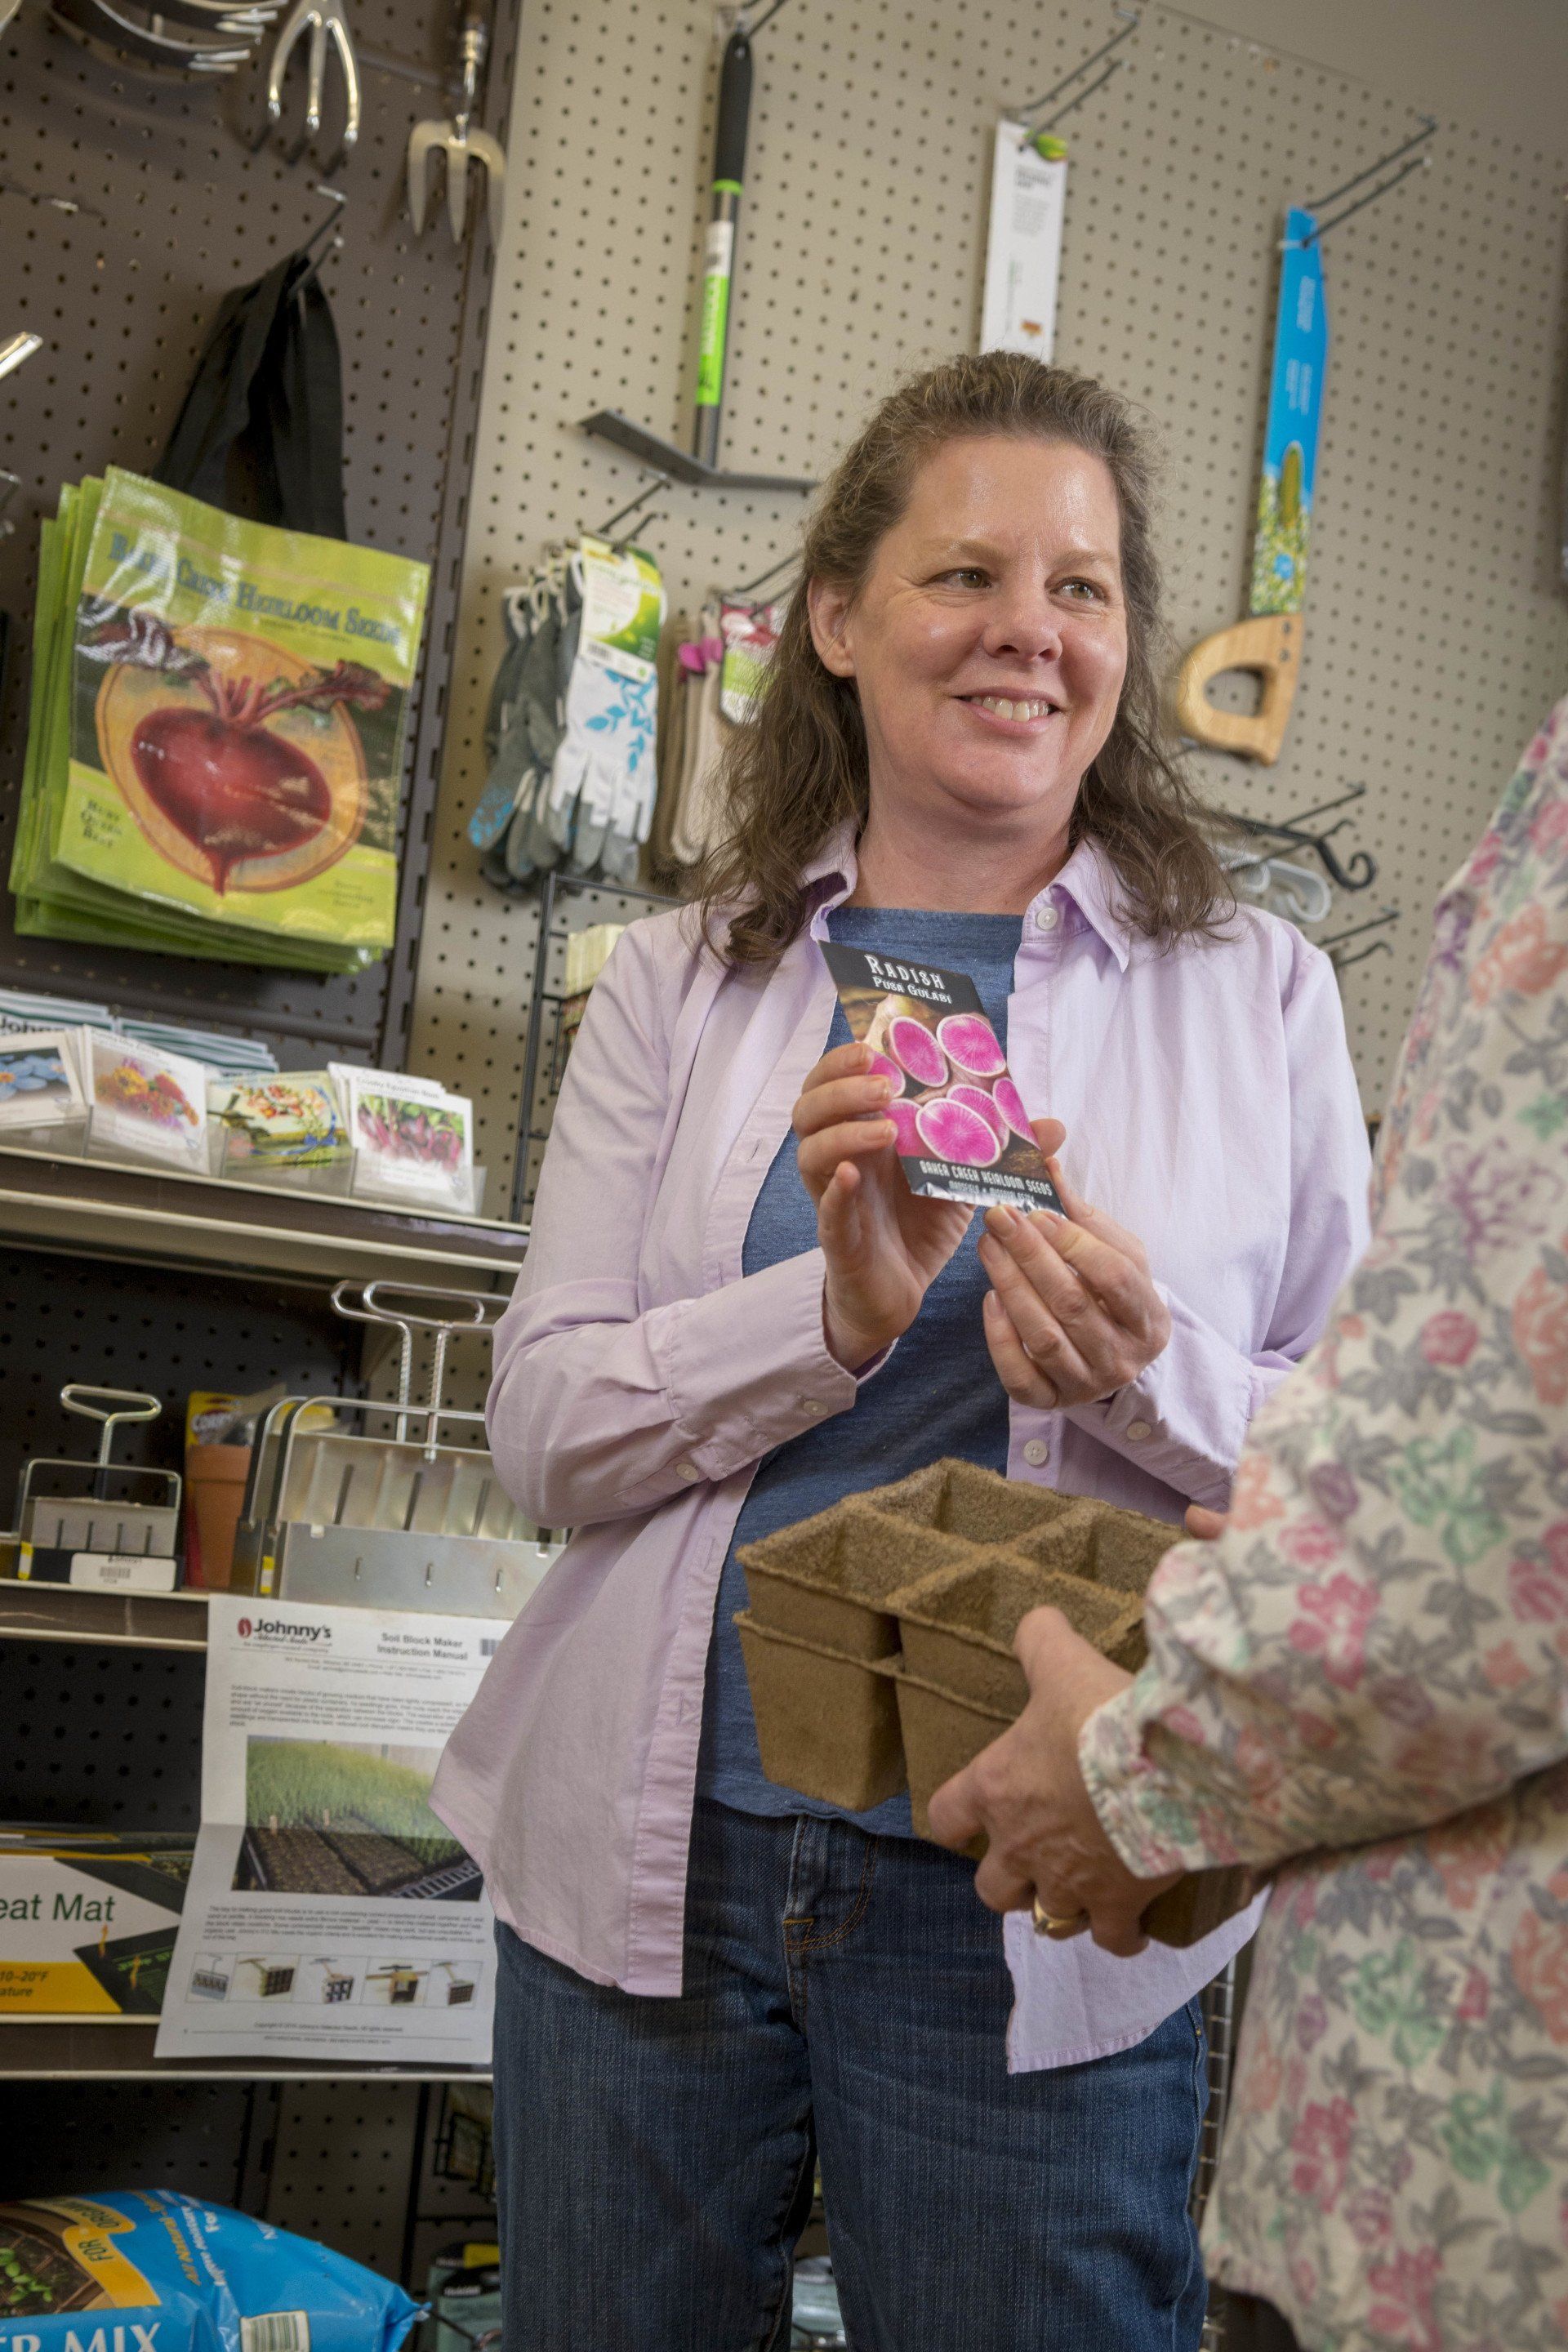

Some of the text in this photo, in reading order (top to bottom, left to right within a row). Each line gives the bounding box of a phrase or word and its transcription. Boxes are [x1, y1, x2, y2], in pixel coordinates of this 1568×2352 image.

[864, 954, 946, 990] RADISH
[872, 976, 953, 1004] PUSA GULABI
[980, 1170, 1025, 1191] HEIRLOOM
[1025, 1179, 1053, 1196] SEEDS
[254, 1619, 331, 1641] Johnny's
[381, 1632, 462, 1647] Soil Block Maker
[376, 1644, 468, 1660] Instruction Manual
[53, 1893, 115, 1921] Mat
[78, 2238, 114, 2261] FOR
[65, 2323, 162, 2352] MIX
